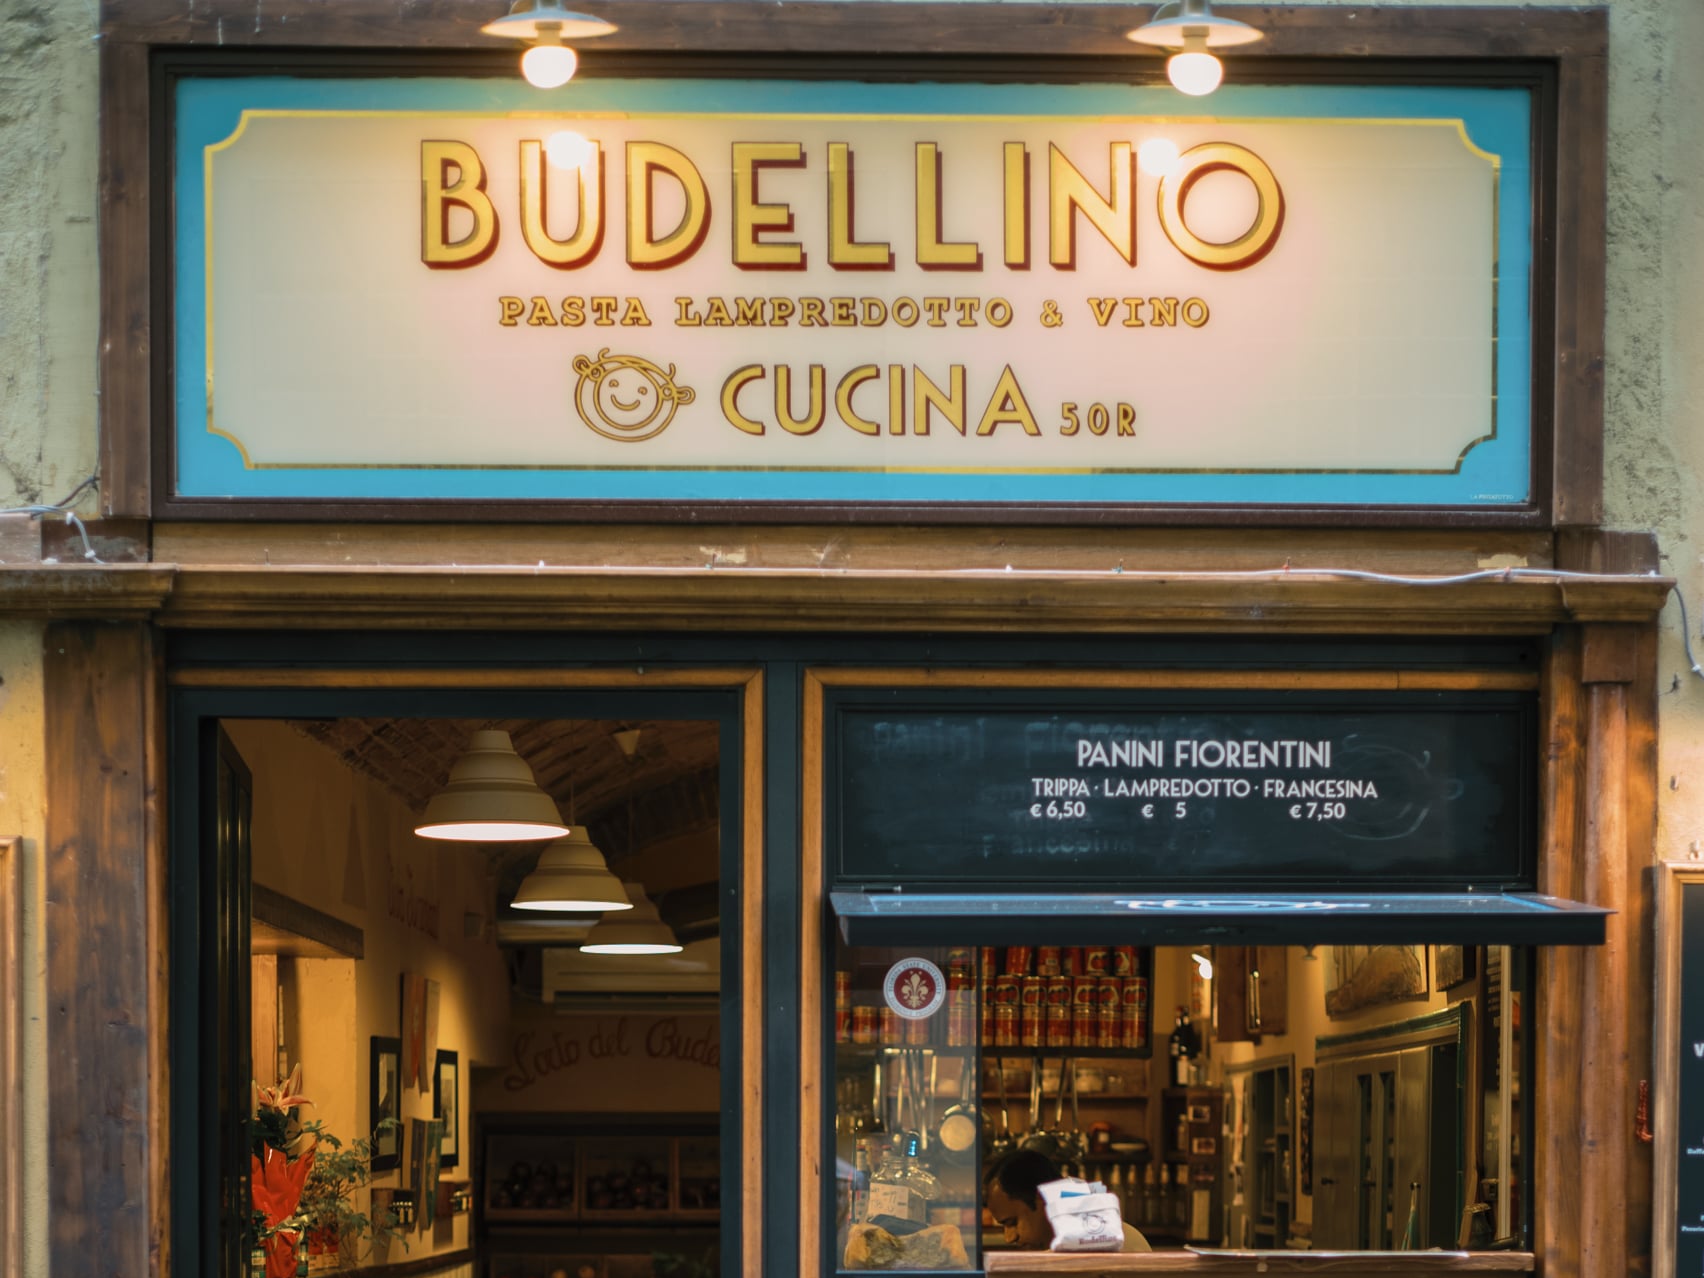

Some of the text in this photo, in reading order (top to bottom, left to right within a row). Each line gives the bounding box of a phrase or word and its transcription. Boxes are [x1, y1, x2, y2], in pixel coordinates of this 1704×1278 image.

[420, 139, 1286, 272] BUDELLINO
[498, 295, 1211, 328] PASTA LAMPREDOTTO & VINO
[720, 363, 1042, 437] CUCINA
[1077, 739, 1331, 768] PANINI FIORENTINI
[1031, 777, 1091, 797] TRIPPA
[1104, 778, 1251, 798] LAMPREDOTTO
[1263, 779, 1378, 799] FRANCESINA
[1141, 803, 1154, 819] €
[1176, 801, 1187, 819] 5
[588, 1016, 631, 1059] del
